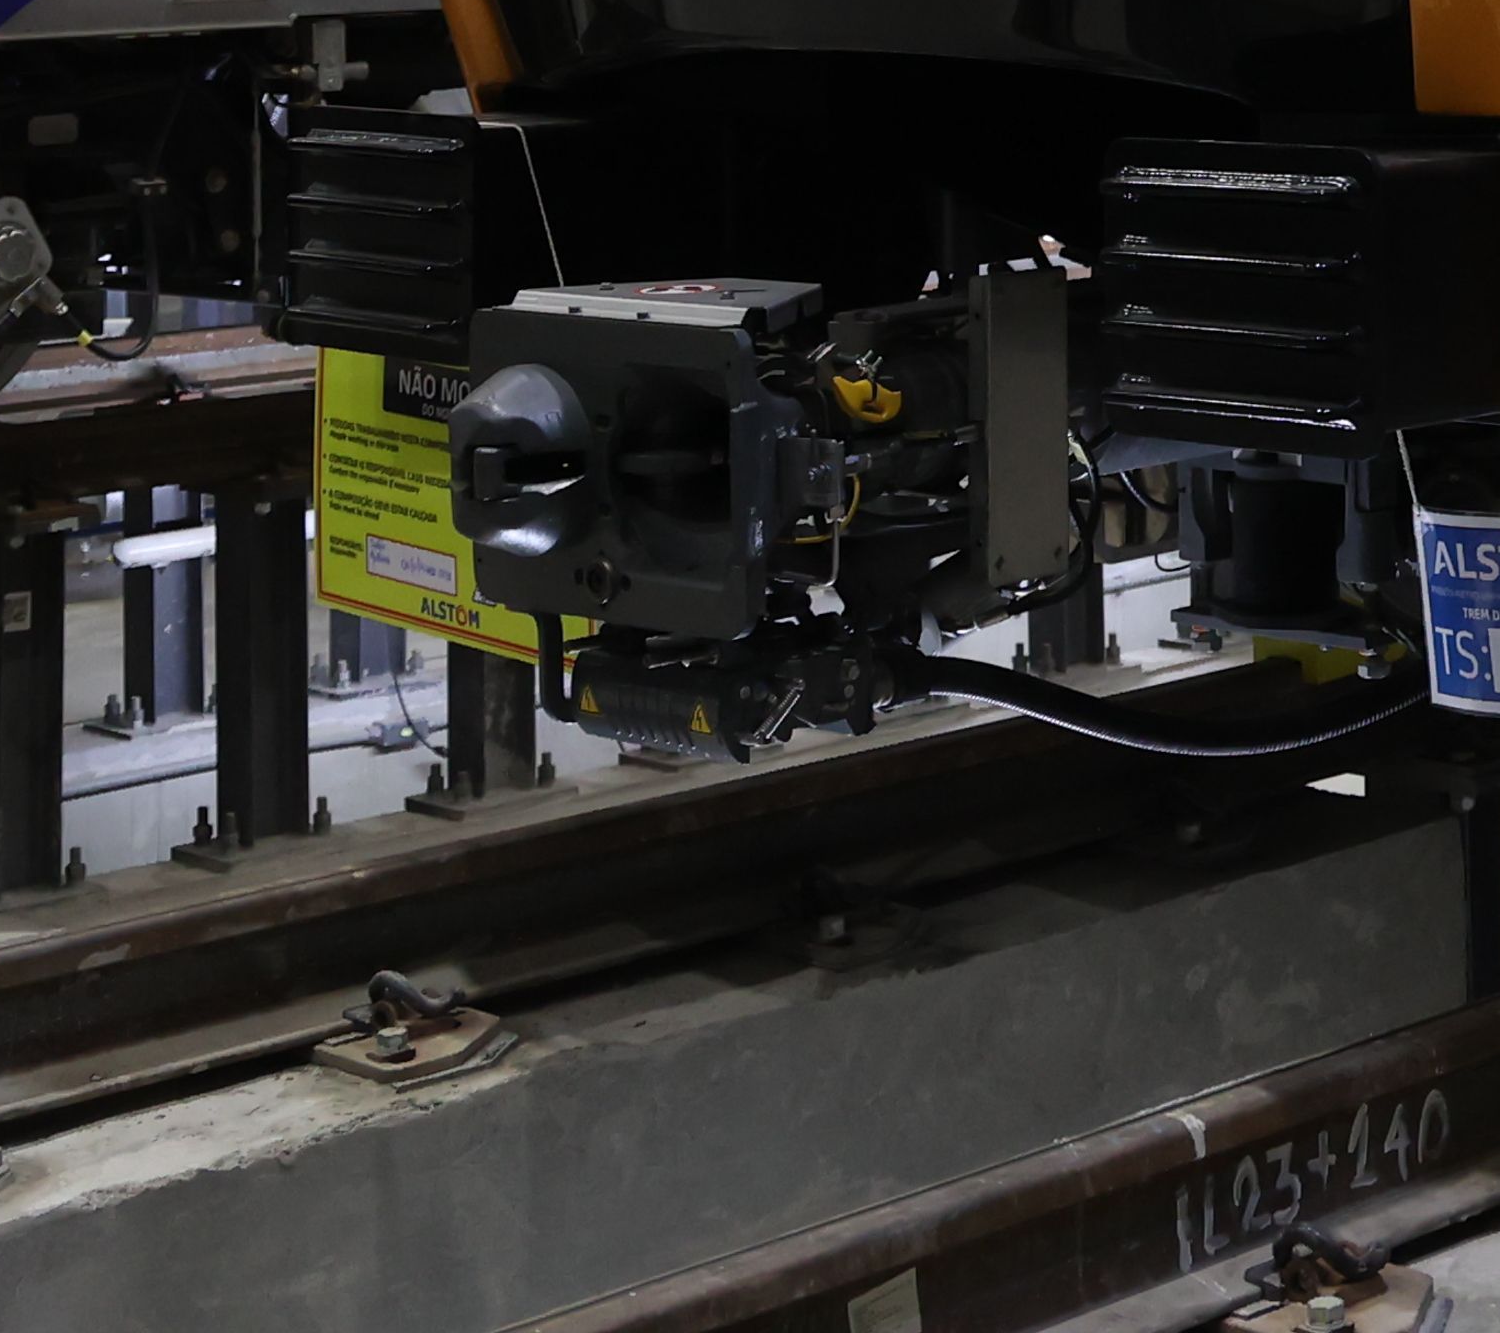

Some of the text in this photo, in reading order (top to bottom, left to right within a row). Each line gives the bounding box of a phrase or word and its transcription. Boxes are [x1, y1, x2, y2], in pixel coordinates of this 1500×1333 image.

[399, 365, 436, 399] NÃO
[421, 597, 480, 629] ALSTOM
[1462, 607, 1490, 621] TREM
[1434, 626, 1492, 681] TS:
